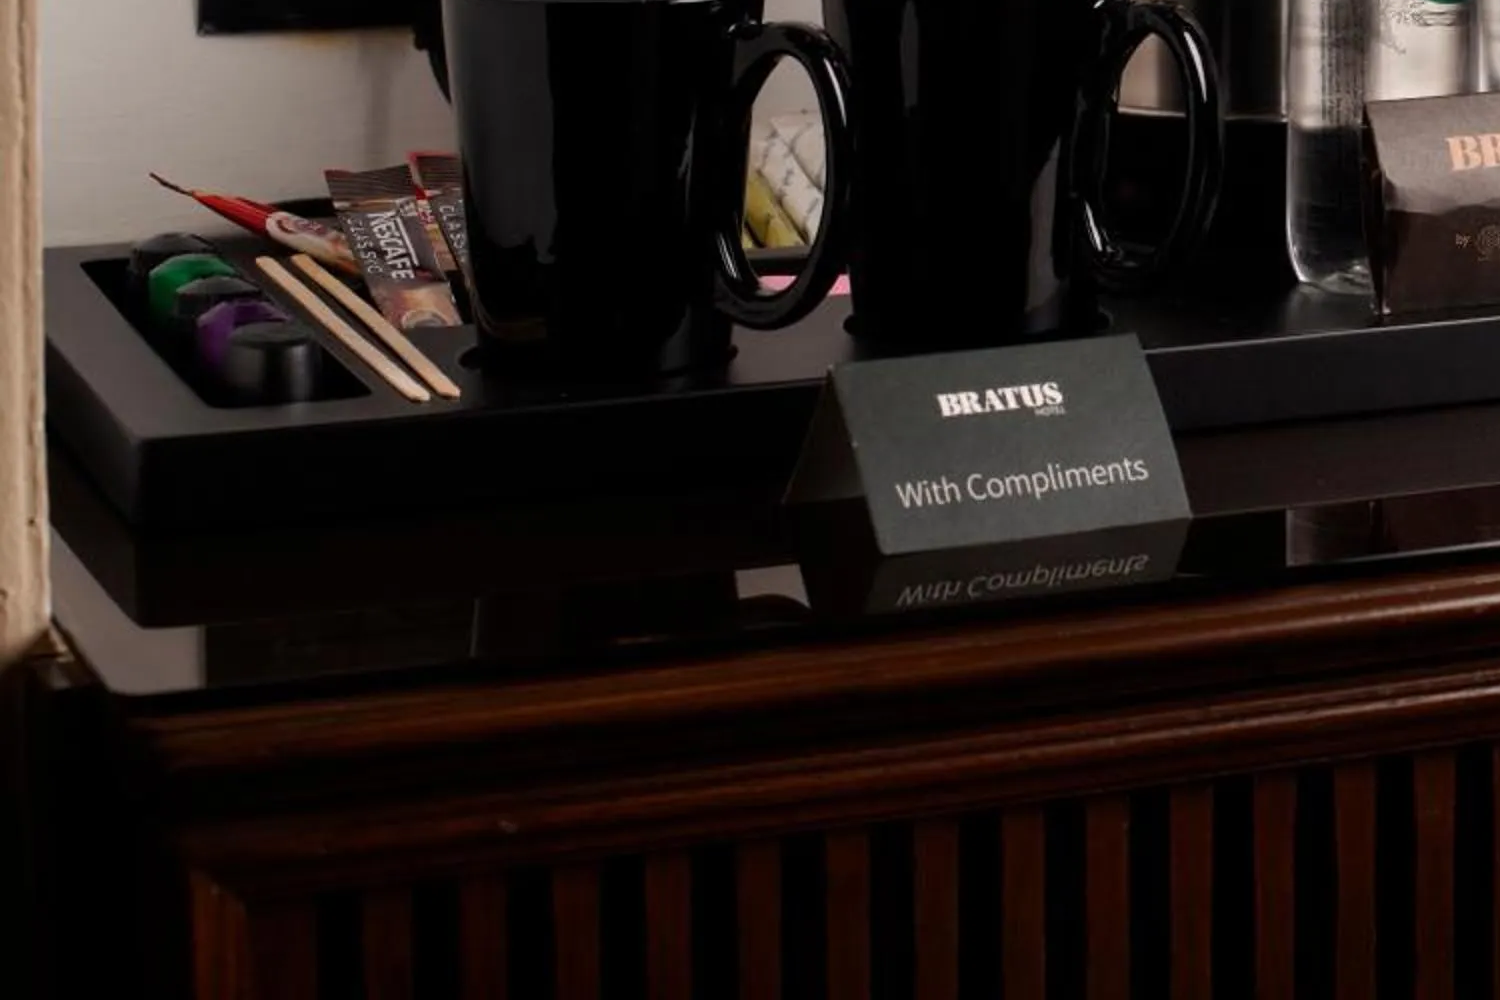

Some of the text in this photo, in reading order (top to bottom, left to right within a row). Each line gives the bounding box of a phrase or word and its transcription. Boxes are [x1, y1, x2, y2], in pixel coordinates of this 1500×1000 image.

[936, 382, 1064, 417] BRATUS
[895, 457, 1150, 509] With Compliments
